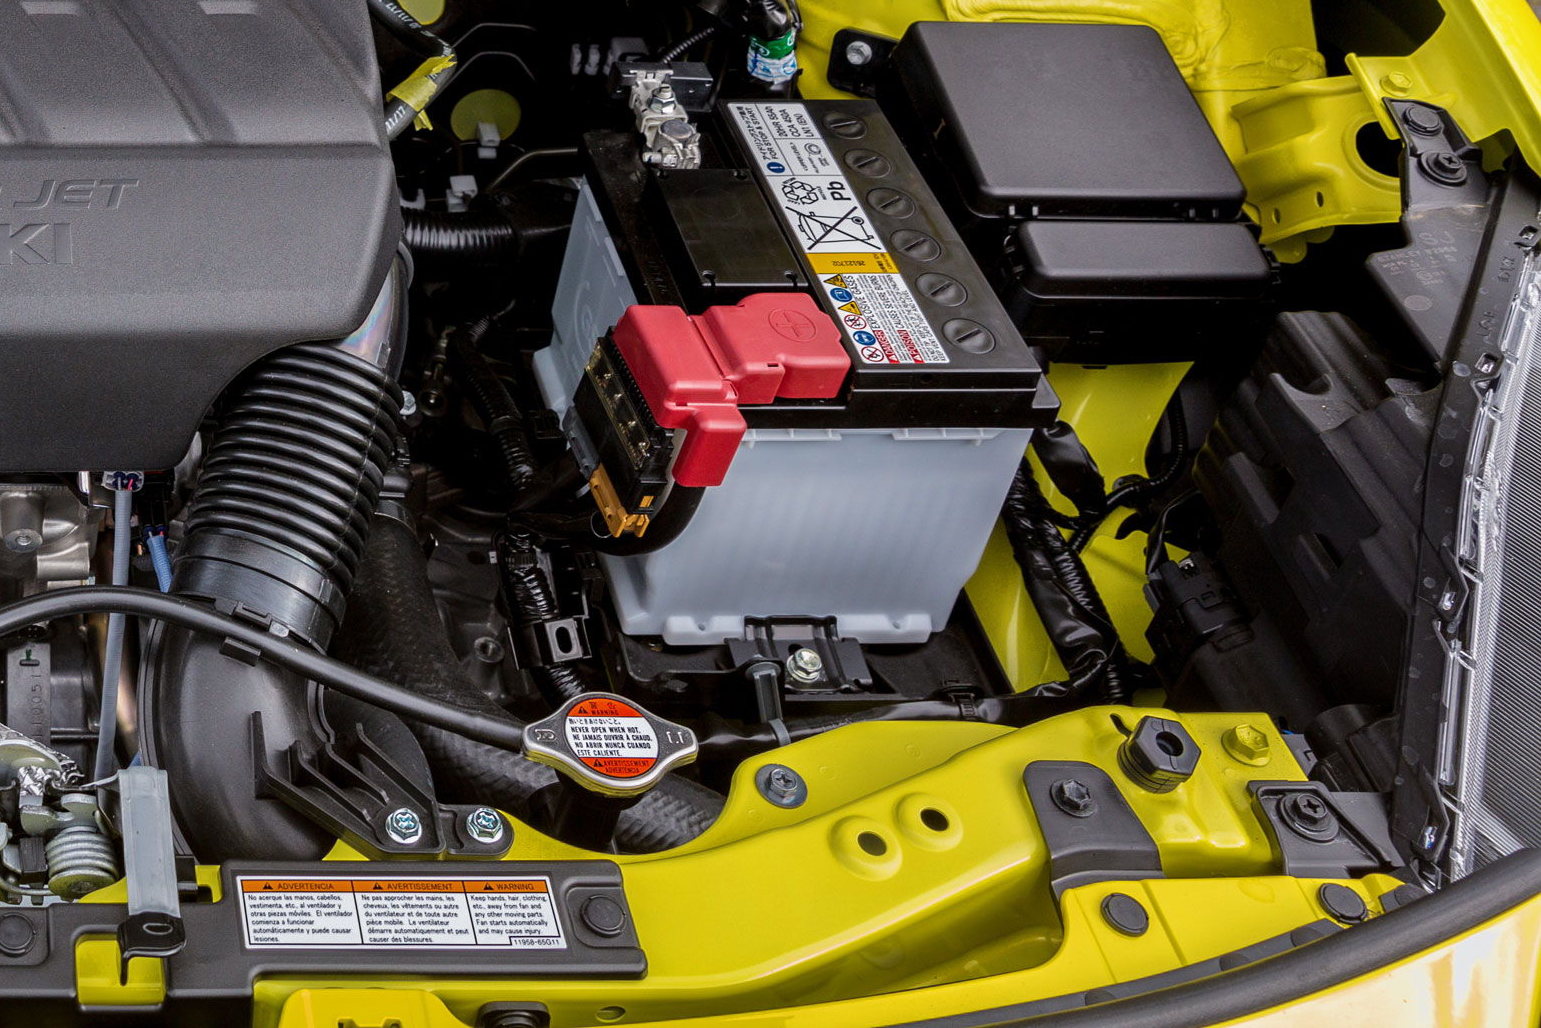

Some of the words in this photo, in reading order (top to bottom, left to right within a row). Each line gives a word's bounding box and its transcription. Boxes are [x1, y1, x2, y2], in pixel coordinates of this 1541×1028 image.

[745, 107, 759, 124] START
[757, 131, 771, 145] STOP
[786, 124, 801, 136] CCA
[767, 147, 778, 158] FOR
[823, 181, 851, 200] Pb
[844, 275, 861, 293] GASES
[867, 275, 883, 289] BURNS
[876, 292, 893, 308] SEVERE
[855, 296, 880, 328] EXPLOSIVE
[886, 310, 904, 328] CAUSES
[873, 331, 894, 354] DANGER
[897, 331, 918, 353] POISON
